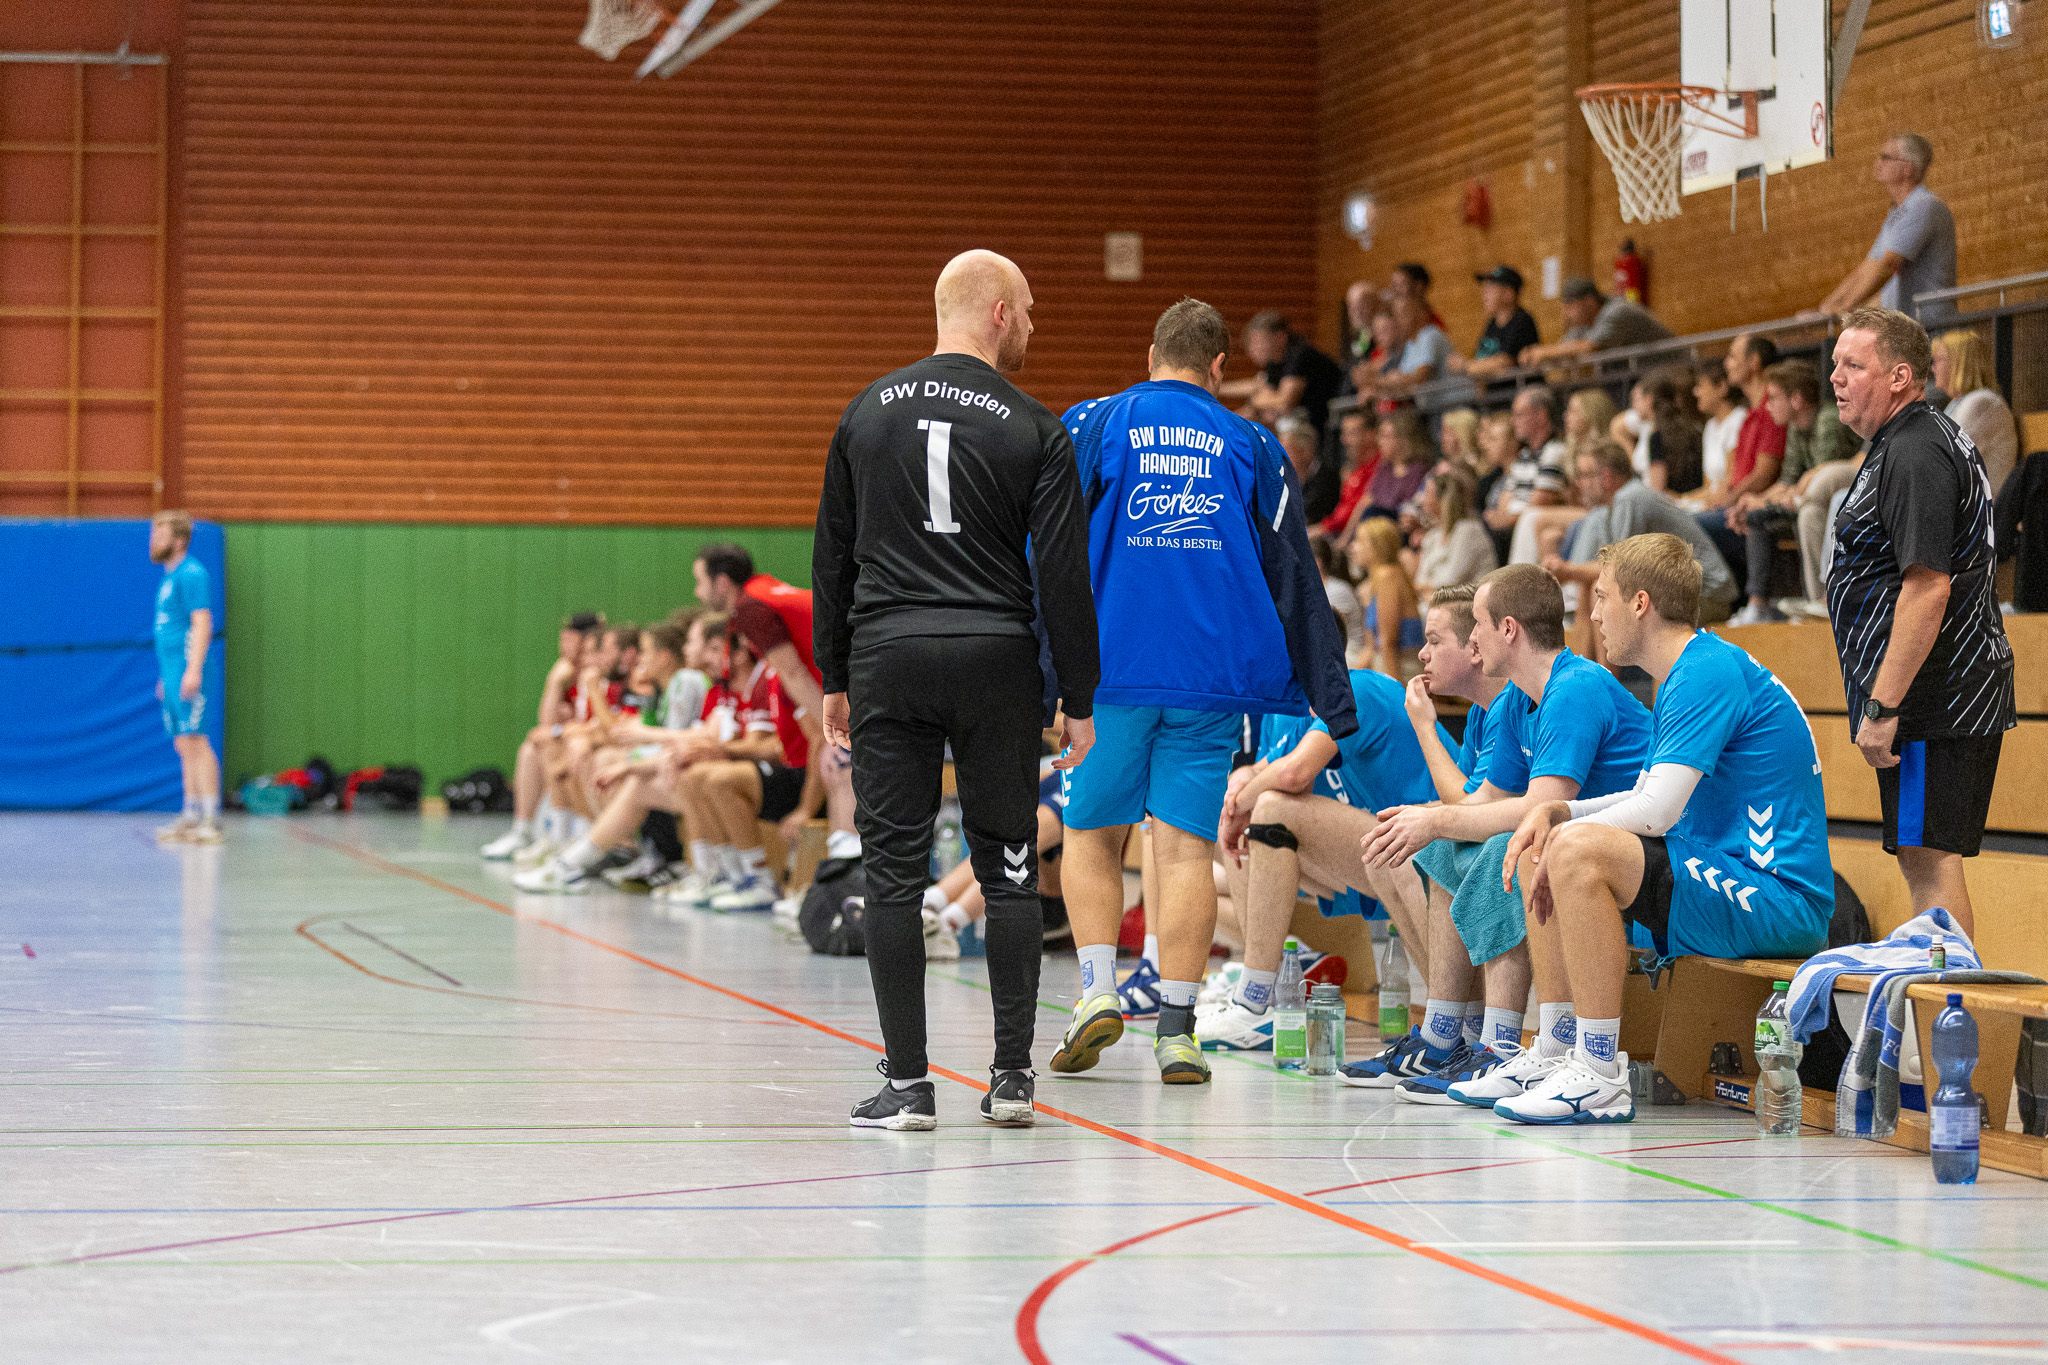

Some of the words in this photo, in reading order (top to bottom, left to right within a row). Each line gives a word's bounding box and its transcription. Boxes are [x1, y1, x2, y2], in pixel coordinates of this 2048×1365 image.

[879, 381, 918, 406] BW
[924, 380, 1011, 420] Dingden
[1128, 425, 1155, 450] BW
[1158, 425, 1225, 458] DINGDEN
[917, 418, 961, 534] 1
[1139, 452, 1213, 479] HANDBALL
[1127, 476, 1225, 520] Görkes
[1126, 536, 1154, 547] NUR
[1156, 536, 1180, 549] DAS
[1182, 538, 1223, 551] BESTE!
